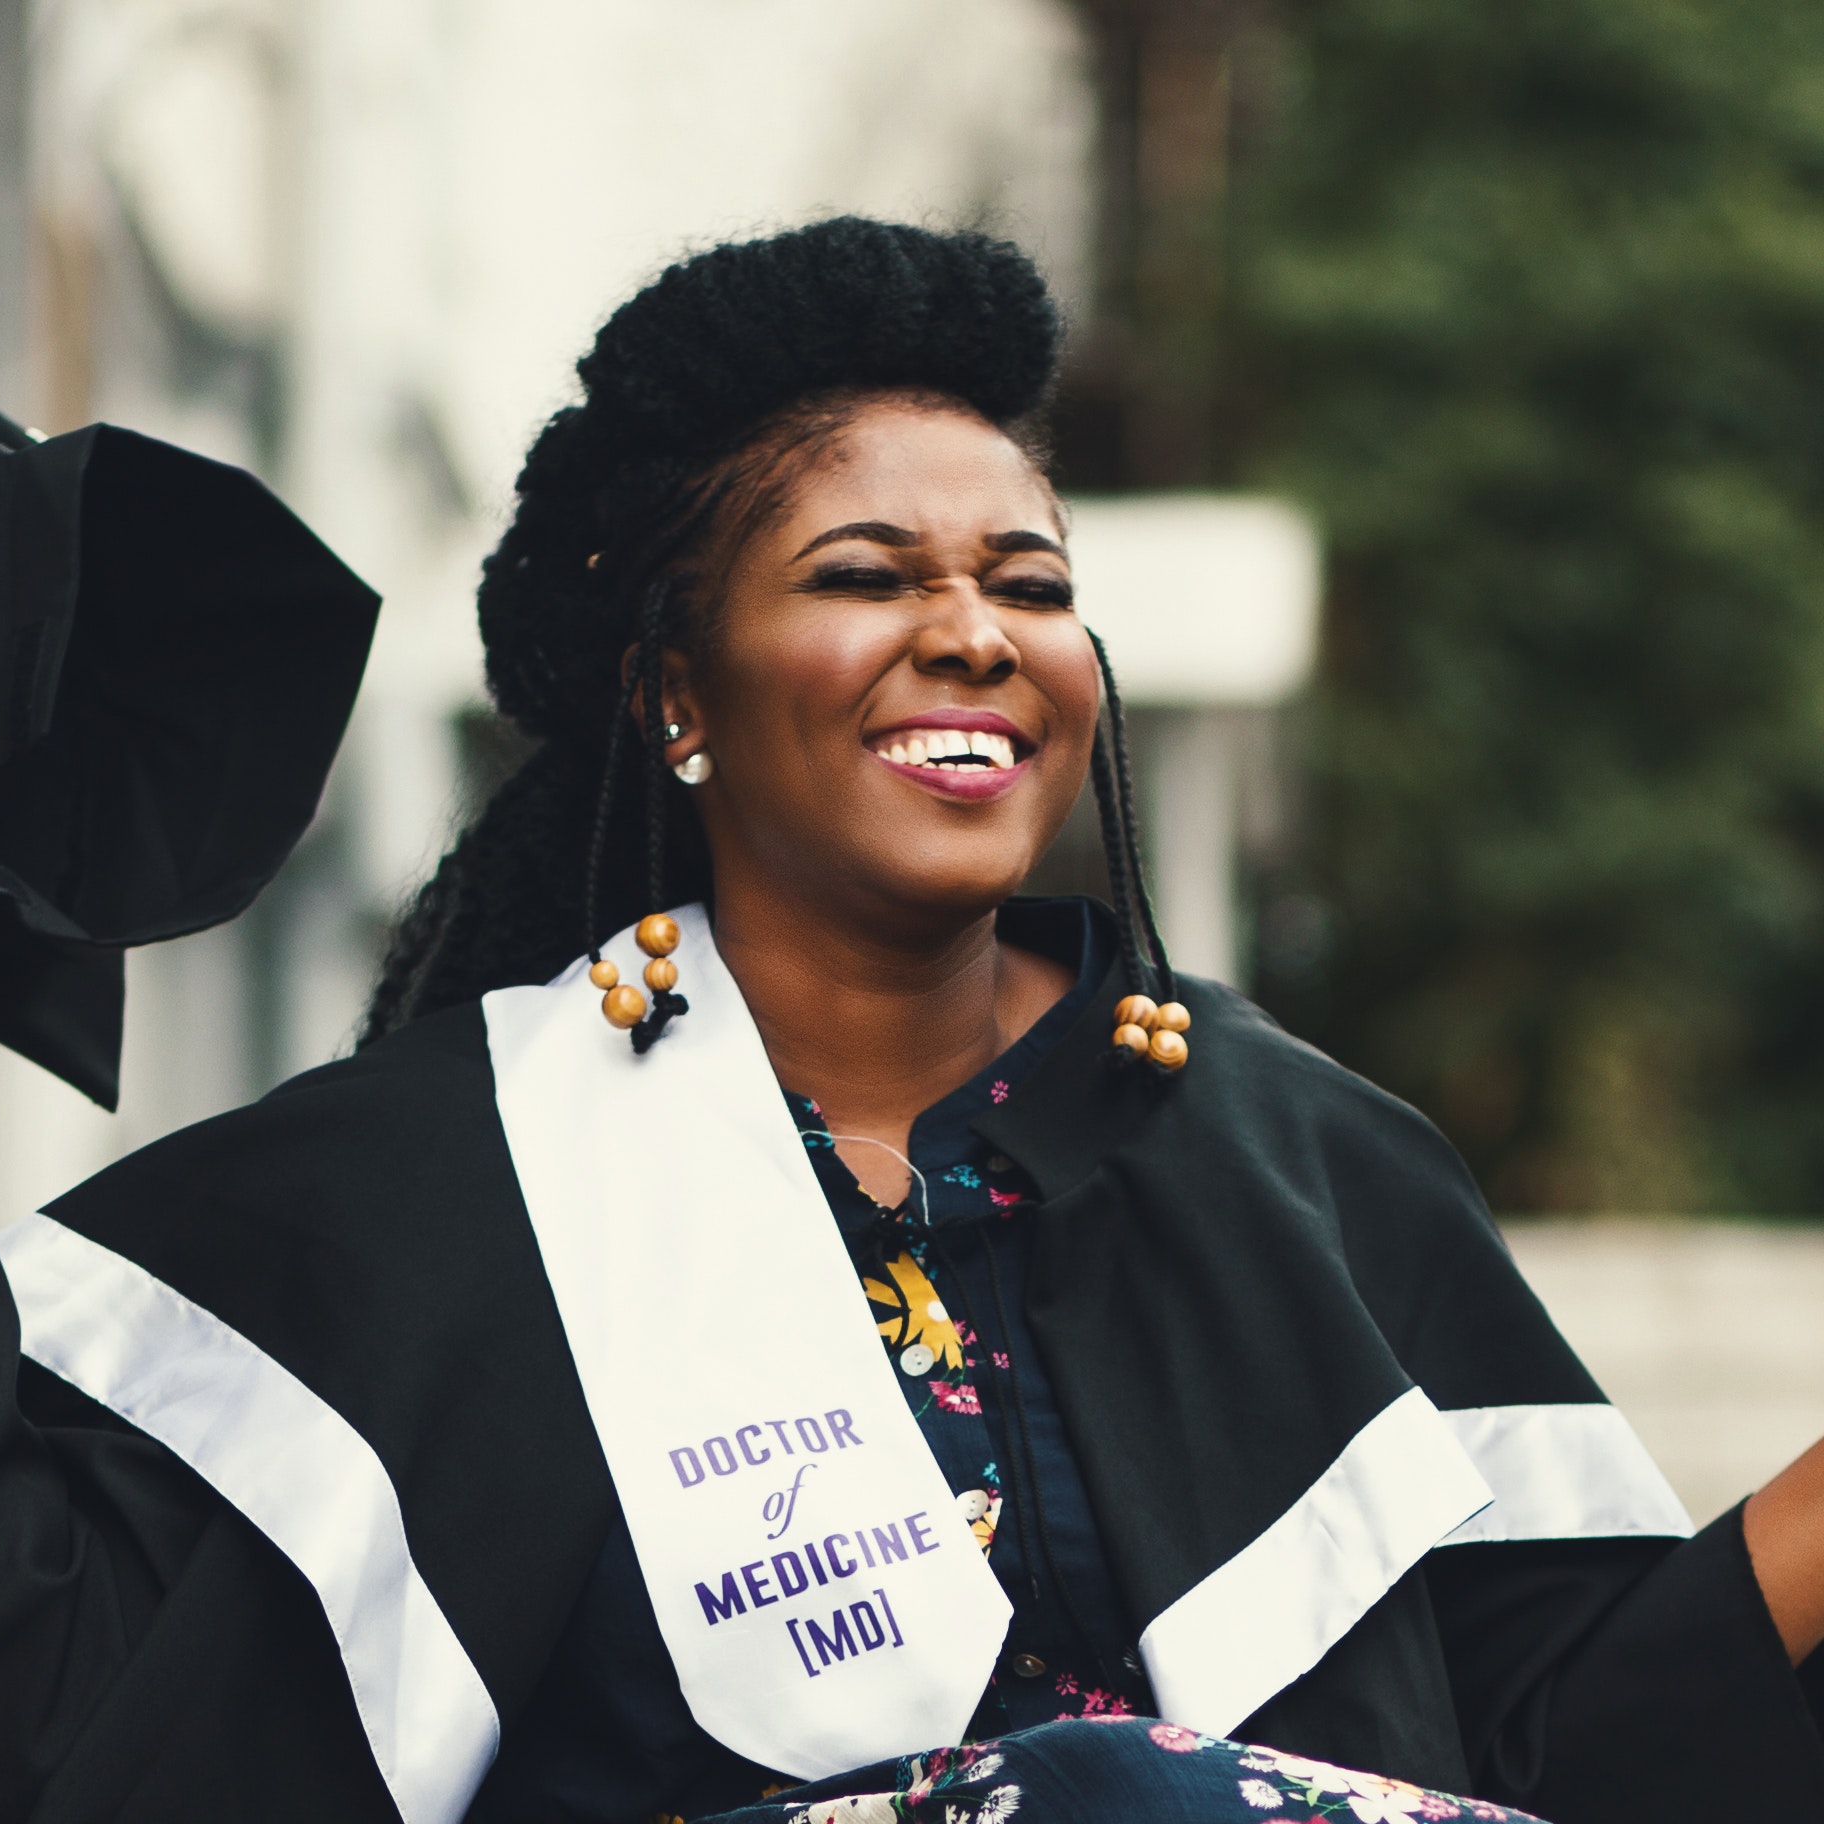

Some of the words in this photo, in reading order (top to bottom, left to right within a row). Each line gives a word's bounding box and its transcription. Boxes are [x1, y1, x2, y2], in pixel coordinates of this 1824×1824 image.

[668, 1408, 864, 1489] DOCTOR
[762, 1463, 818, 1540] of
[694, 1511, 940, 1626] MEDICINE
[786, 1588, 904, 1678] [MD]
